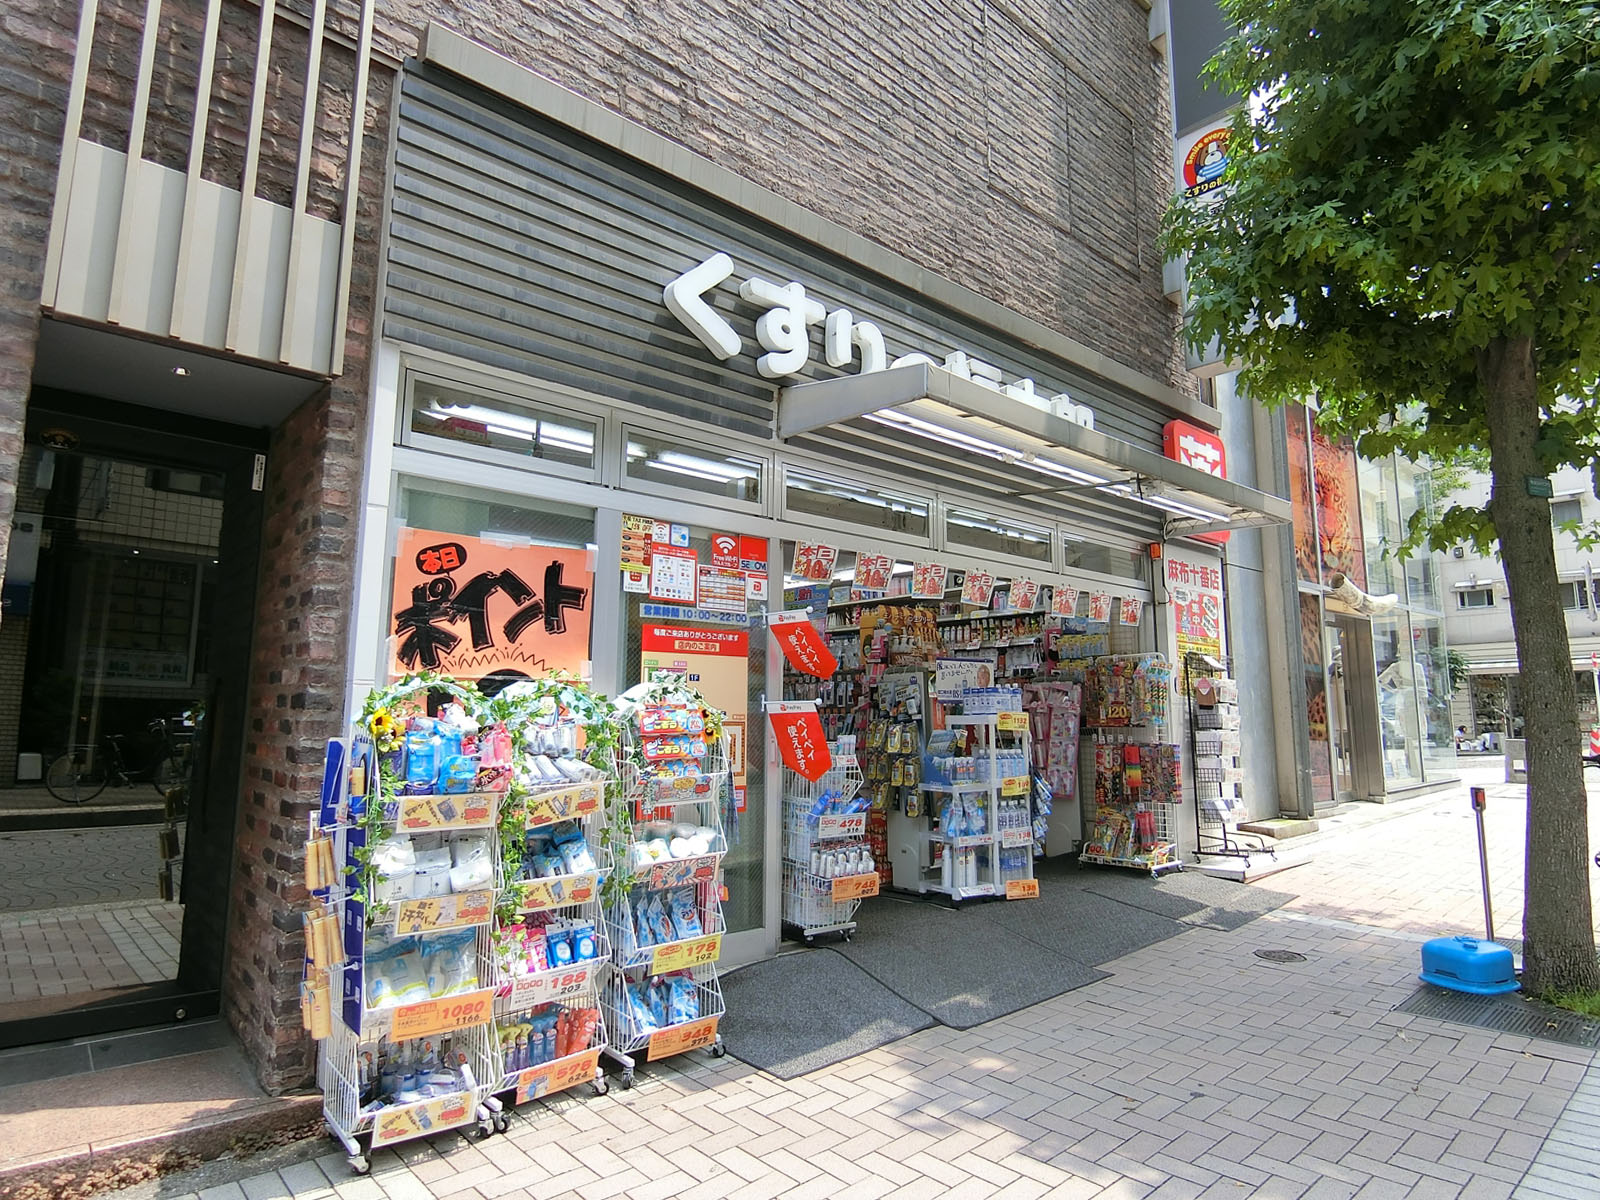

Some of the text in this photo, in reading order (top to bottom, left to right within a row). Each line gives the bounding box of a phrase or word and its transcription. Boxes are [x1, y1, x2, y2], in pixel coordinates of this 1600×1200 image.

[1186, 142, 1203, 165] Smile
[420, 546, 460, 572] 本日
[800, 545, 836, 561] 本日
[741, 560, 767, 570] SECOM
[861, 556, 894, 570] 本日
[1168, 558, 1220, 590] 麻布十番店
[395, 560, 588, 670] ポイント
[644, 605, 680, 618] 営業時間
[654, 628, 739, 642] 毎度ご来店ありがとうございます
[678, 642, 717, 650] 店内のご案内
[795, 627, 820, 664] ペイペイ
[1108, 706, 1127, 718] 120
[797, 717, 815, 761] ペイペイ
[840, 818, 862, 828] 478
[854, 880, 876, 890] 748
[686, 941, 717, 957] 178
[552, 971, 587, 989] 188
[560, 984, 581, 994] 203
[442, 1000, 485, 1019] 1080
[456, 1014, 480, 1025] 1166
[682, 1026, 712, 1042] 348
[691, 1036, 708, 1046] 375
[556, 1060, 592, 1080] 578
[568, 1071, 588, 1083] 624
